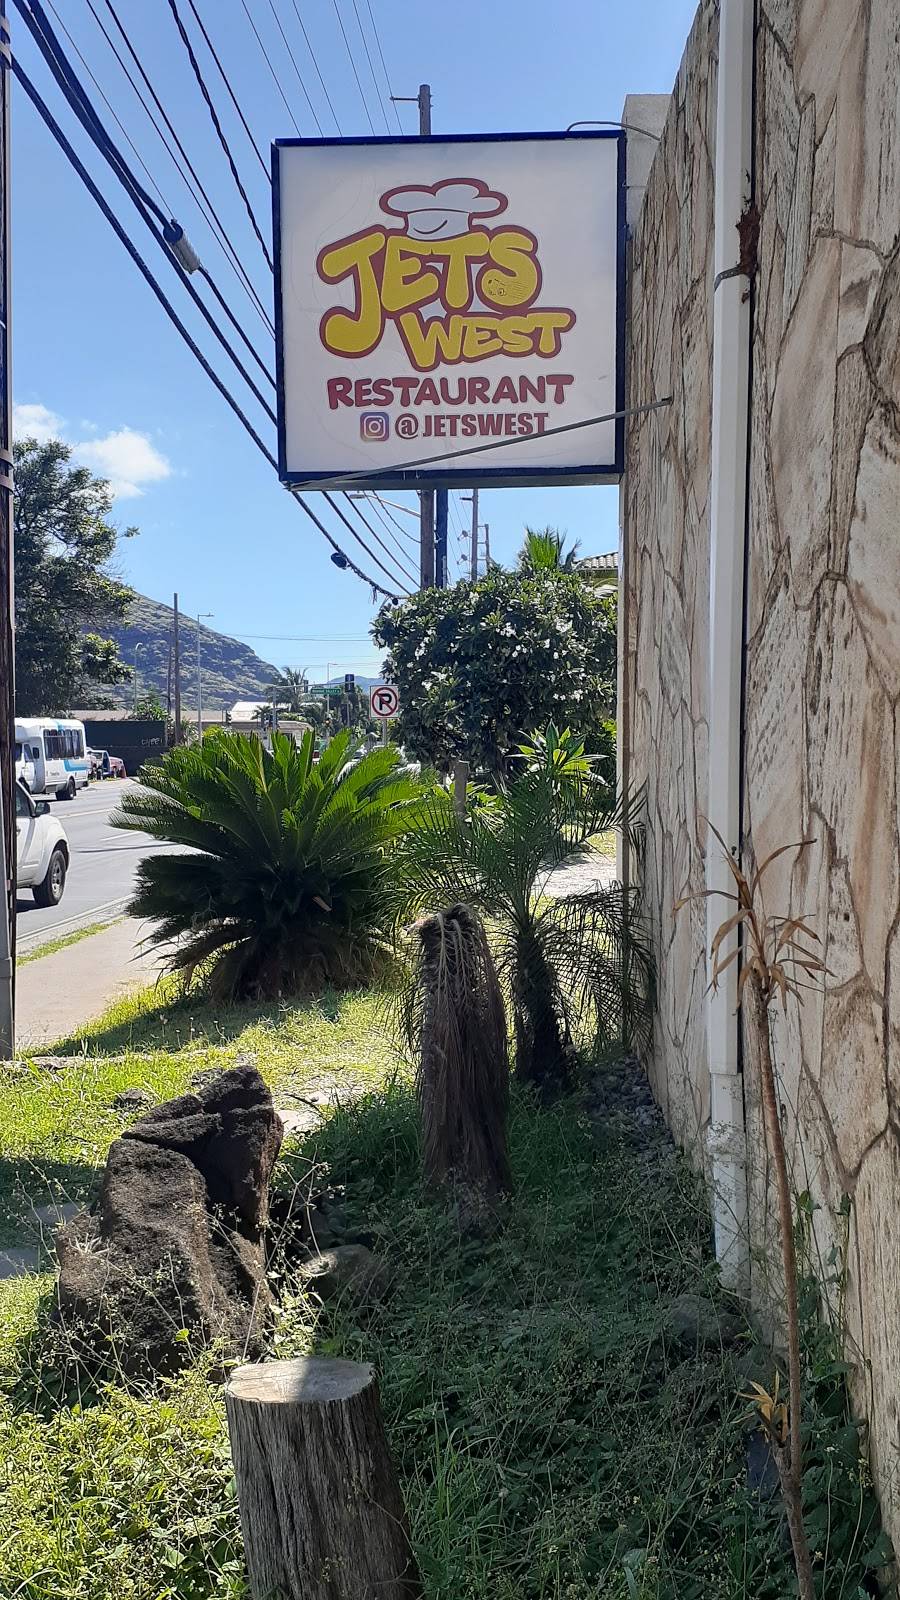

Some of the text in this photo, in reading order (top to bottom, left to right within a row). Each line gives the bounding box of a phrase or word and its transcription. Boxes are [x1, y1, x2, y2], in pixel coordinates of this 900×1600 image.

[317, 225, 541, 358] JETS
[398, 309, 575, 371] WEST
[327, 374, 574, 409] RESTAURANT
[395, 412, 549, 440] @JETSWEST
